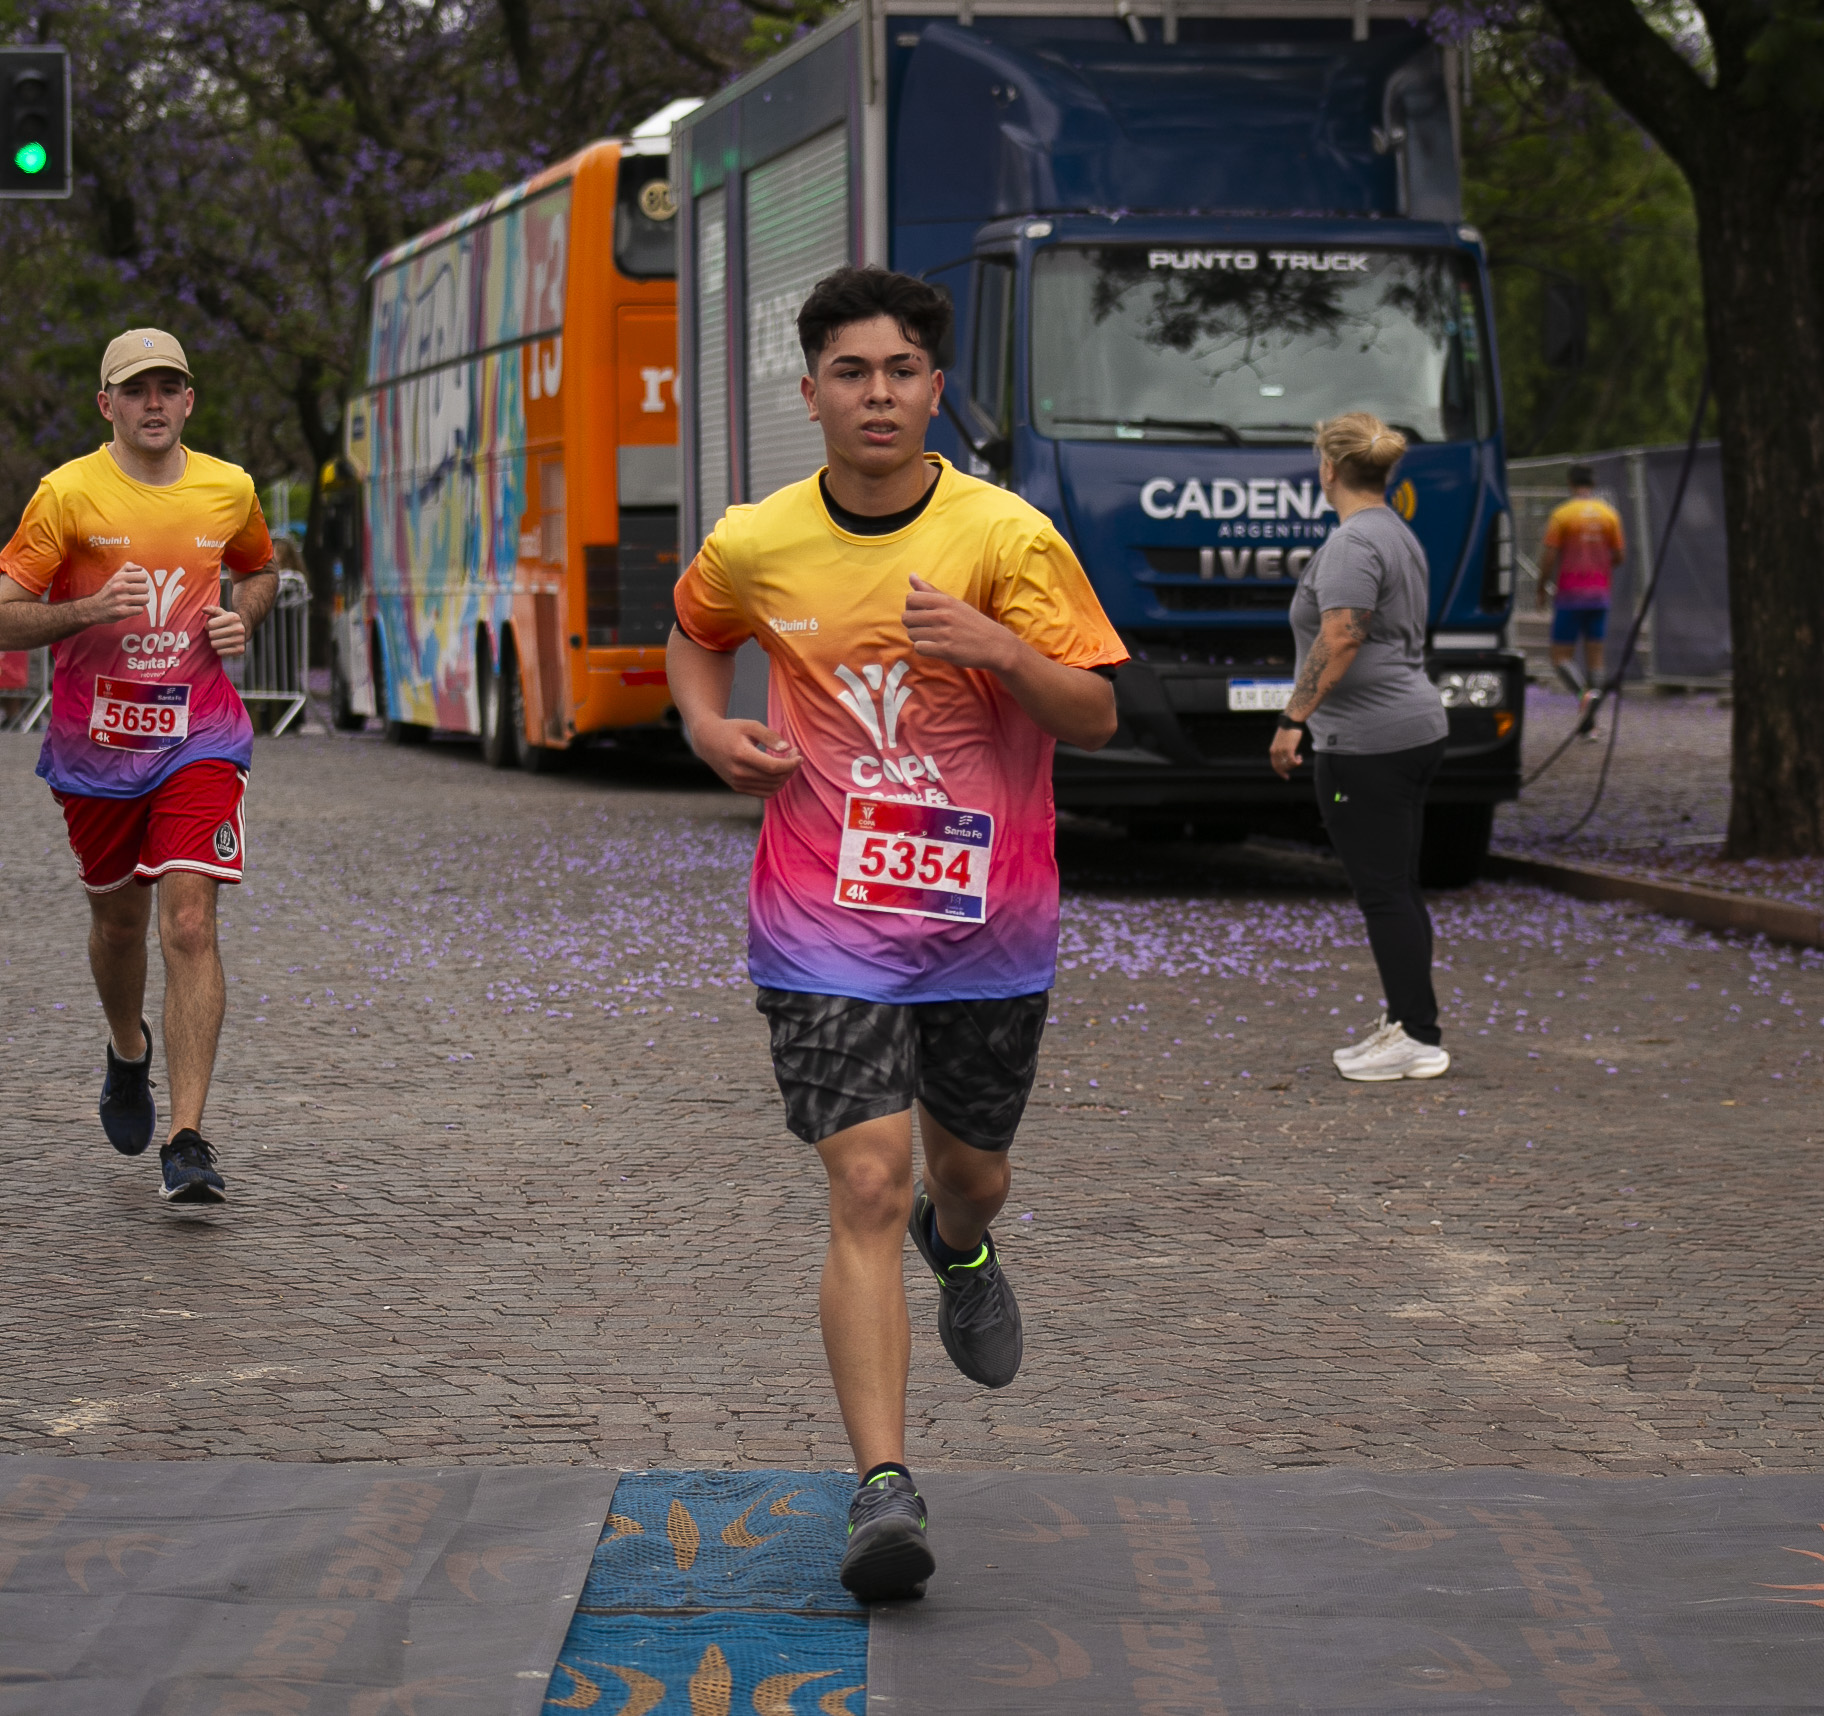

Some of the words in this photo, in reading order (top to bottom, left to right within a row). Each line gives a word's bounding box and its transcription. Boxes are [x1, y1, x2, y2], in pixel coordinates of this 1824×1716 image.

[1148, 250, 1257, 270] PUNTO
[1269, 252, 1368, 271] TRUCK
[1140, 477, 1338, 519] CADENA
[123, 535, 131, 545] 6
[1200, 546, 1314, 580] IVEC
[810, 617, 819, 631] 6
[122, 632, 190, 654] COPA
[127, 656, 166, 670] Santa
[103, 702, 176, 734] 5659
[95, 731, 111, 743] 4k
[851, 755, 944, 788] COPA
[858, 819, 876, 827] COPA
[944, 825, 971, 838] Santa
[972, 829, 983, 840] Fe
[859, 837, 971, 890] 5354
[846, 883, 869, 902] 4k
